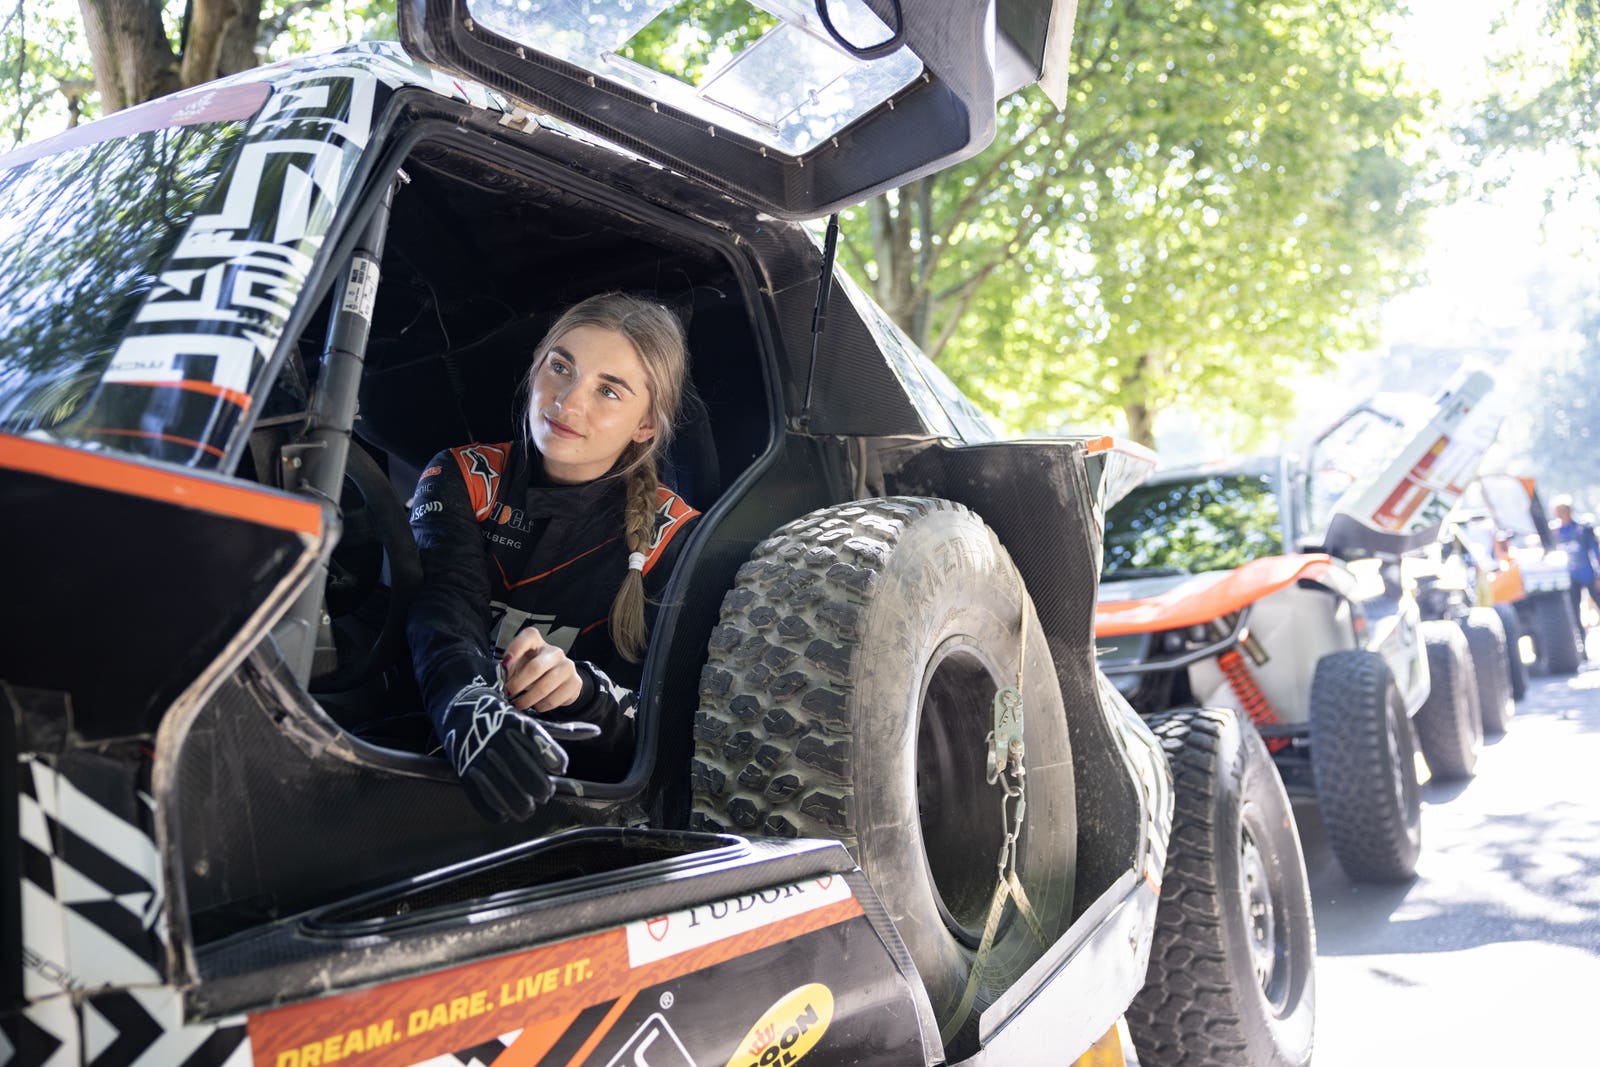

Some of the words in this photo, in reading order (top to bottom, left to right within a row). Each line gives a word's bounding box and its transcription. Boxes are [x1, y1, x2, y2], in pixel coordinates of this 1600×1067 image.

[275, 1018, 402, 1067] DREAM.
[406, 989, 495, 1038] DARE.
[499, 967, 561, 1008] LIVE
[563, 957, 594, 987] IT.
